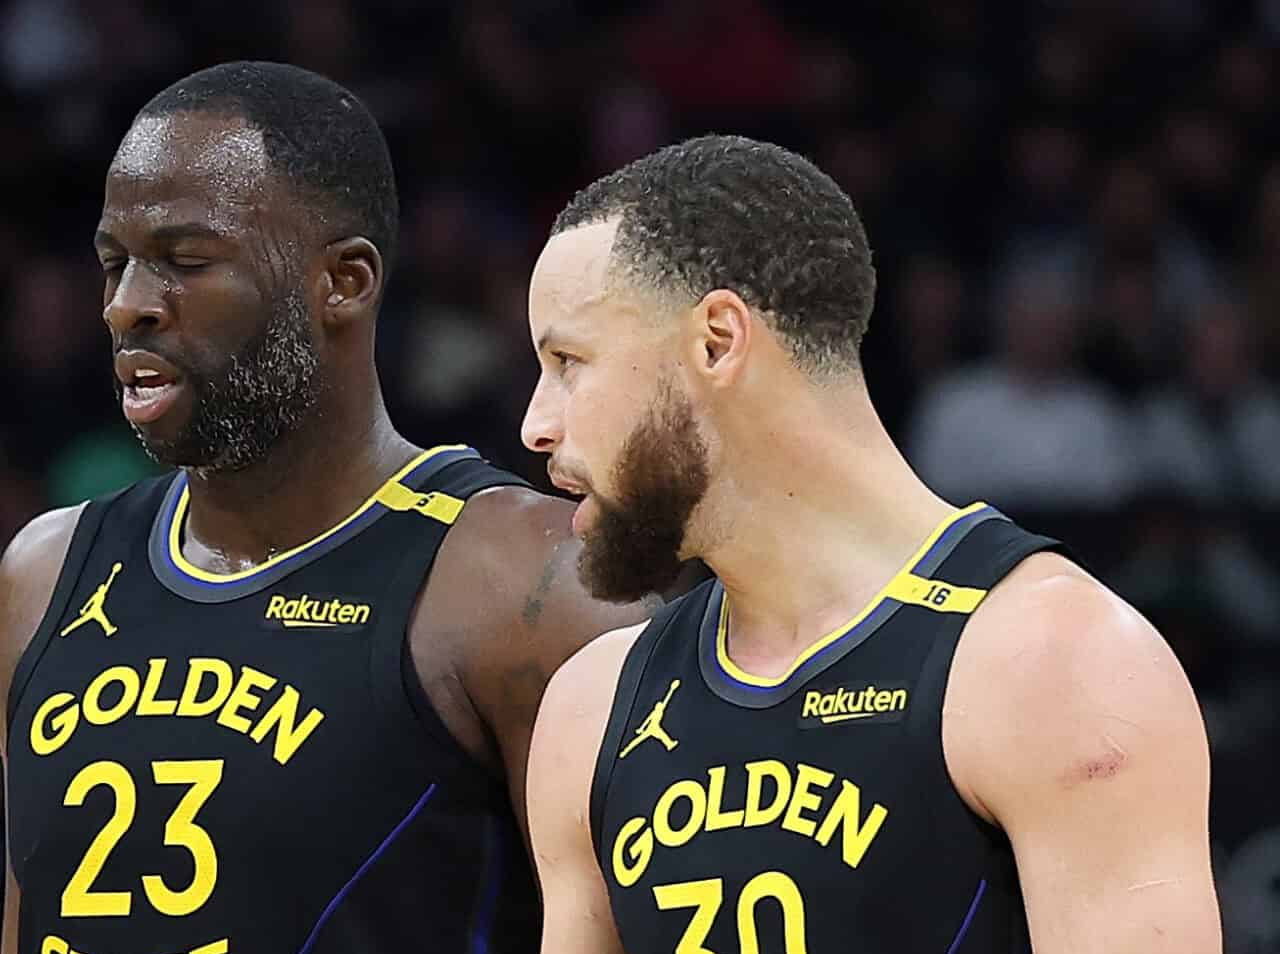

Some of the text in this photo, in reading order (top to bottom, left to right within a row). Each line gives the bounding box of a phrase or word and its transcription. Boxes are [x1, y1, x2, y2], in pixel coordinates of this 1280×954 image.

[266, 595, 371, 625] Rakuten
[922, 584, 951, 606] 16
[29, 657, 325, 766] GOLDEN
[802, 686, 907, 720] Rakuten
[60, 759, 226, 918] 23
[610, 759, 889, 888] GOLDEN
